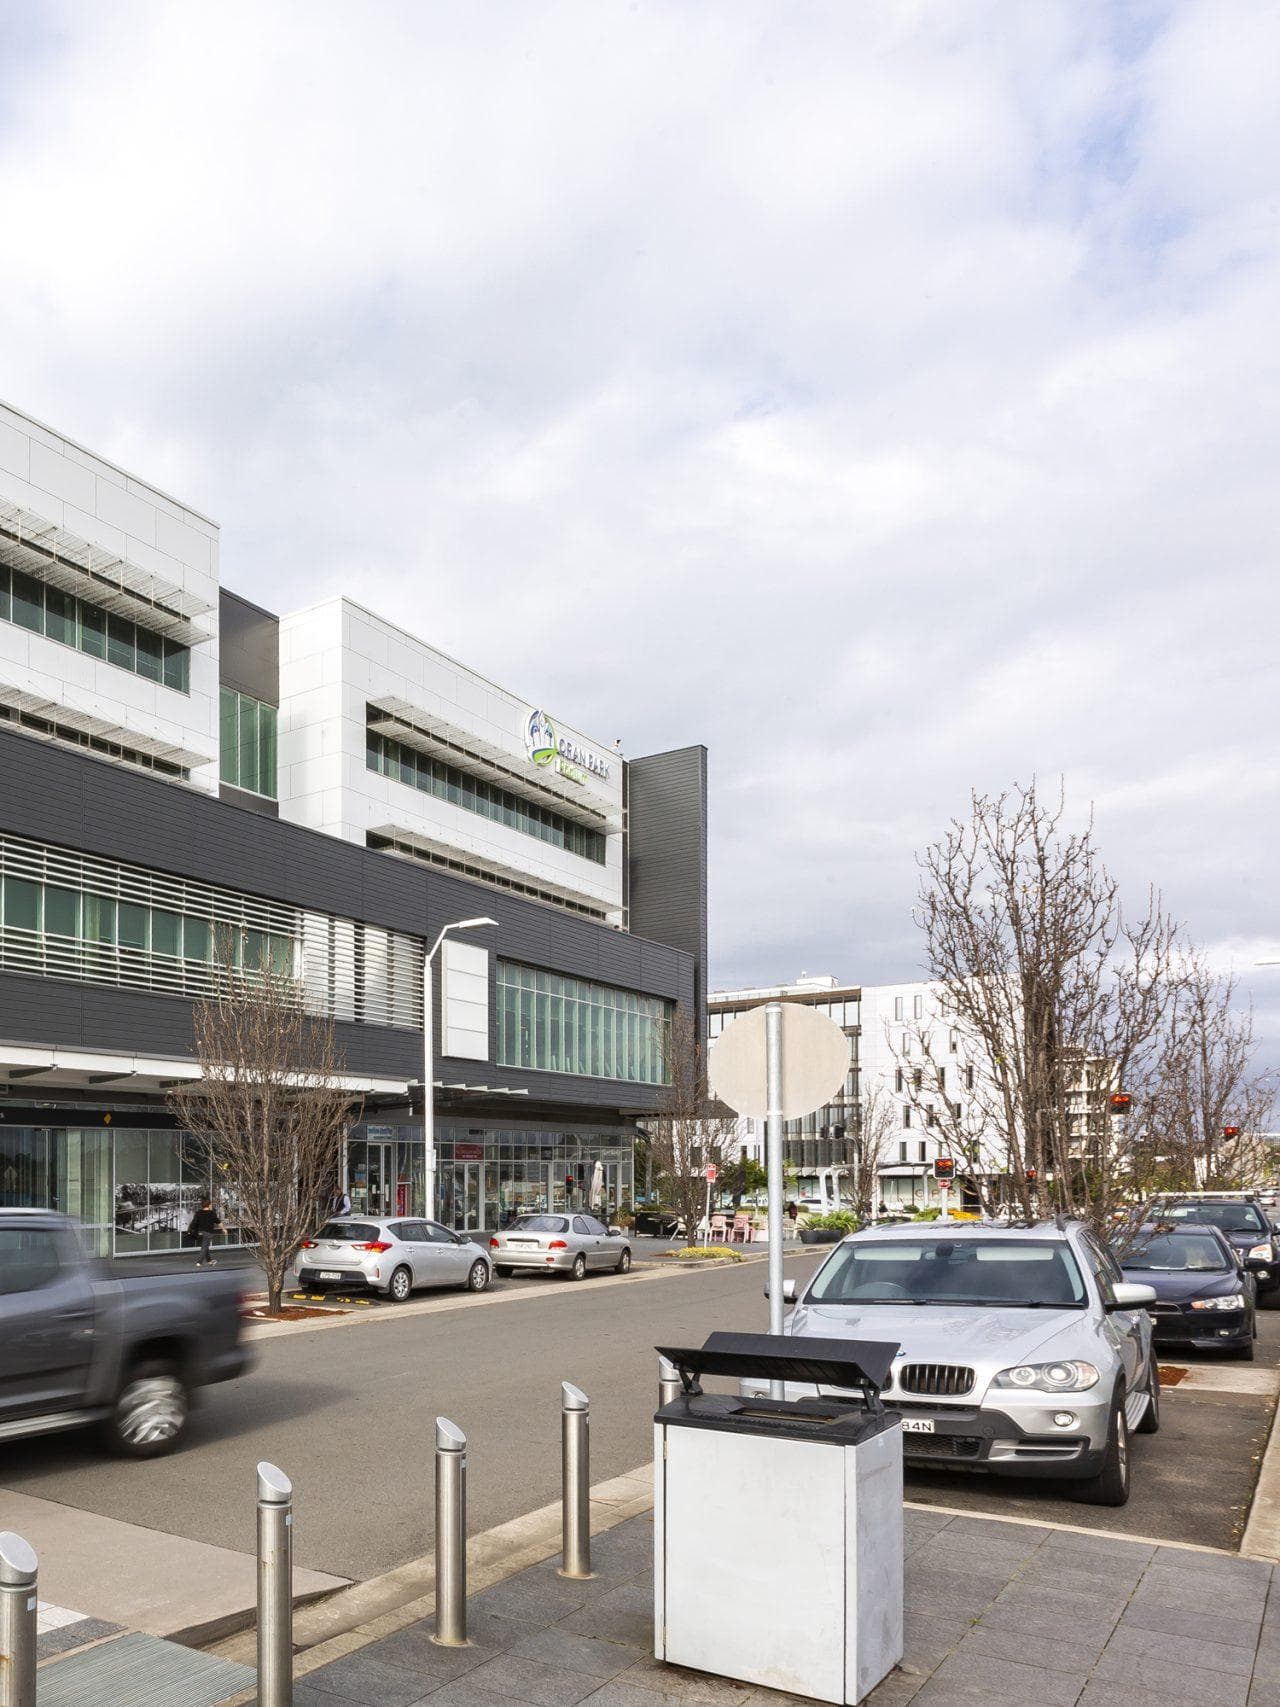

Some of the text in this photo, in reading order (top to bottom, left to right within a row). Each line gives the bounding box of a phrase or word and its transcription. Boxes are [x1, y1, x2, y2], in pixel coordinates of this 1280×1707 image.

[559, 738, 610, 780] ORAN PARK
[901, 1421, 932, 1432] 84N
